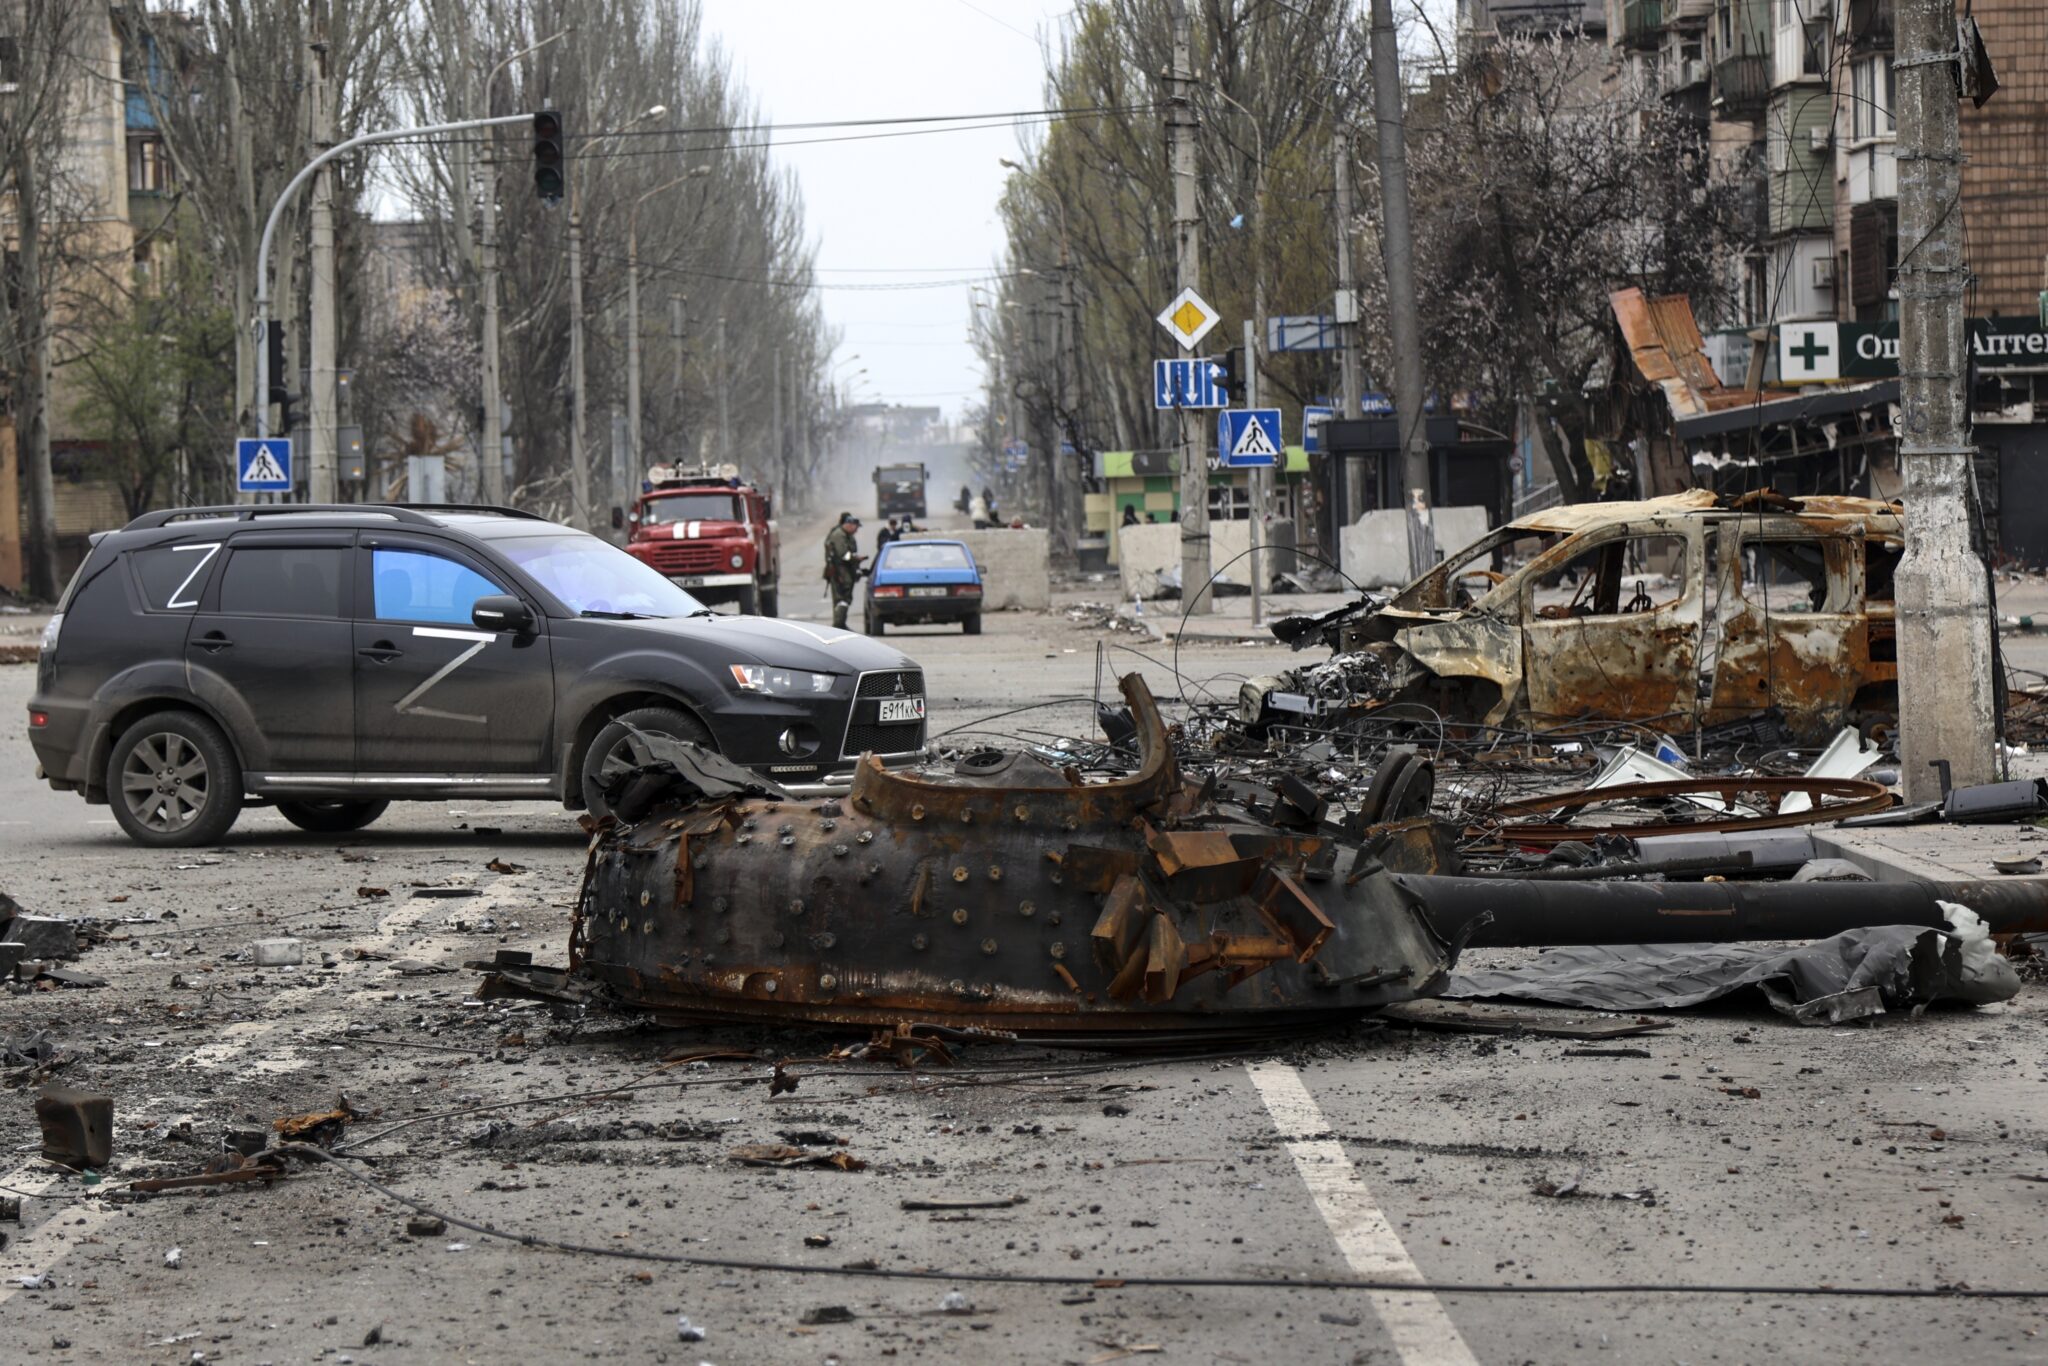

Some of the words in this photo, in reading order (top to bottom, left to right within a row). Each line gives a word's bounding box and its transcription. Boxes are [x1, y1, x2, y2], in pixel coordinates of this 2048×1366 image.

[1965, 329, 2048, 355] Апте
[896, 481, 910, 493] Z
[167, 543, 221, 608] Z
[394, 627, 497, 723] Z
